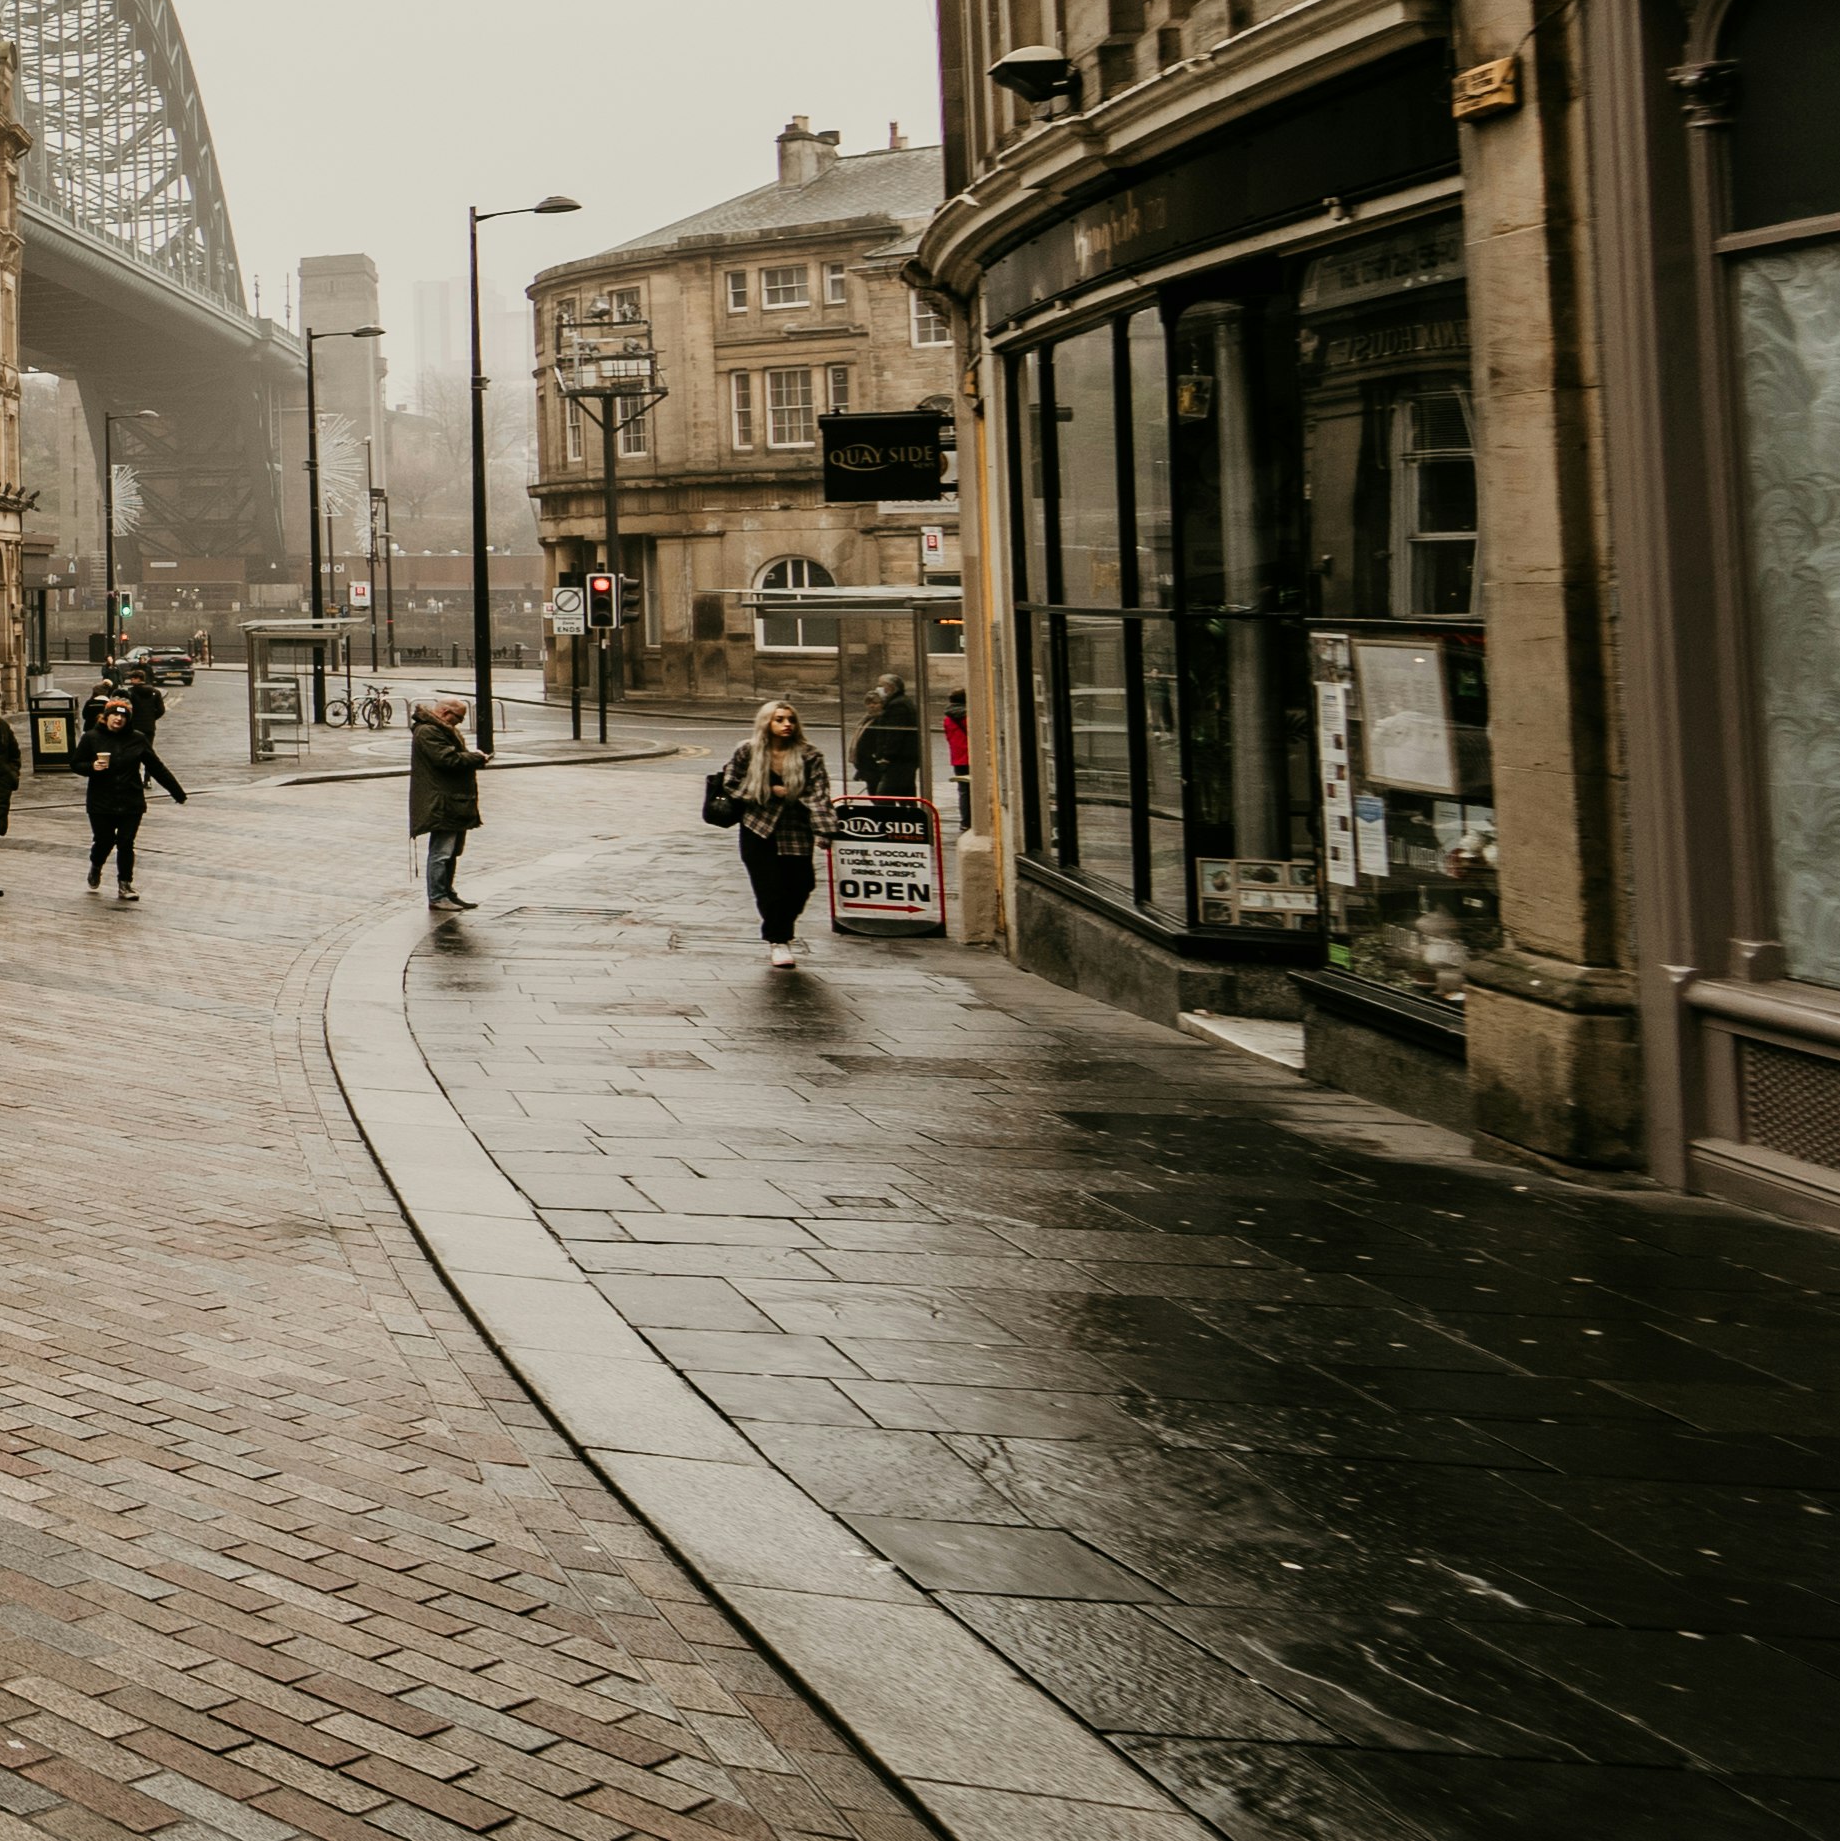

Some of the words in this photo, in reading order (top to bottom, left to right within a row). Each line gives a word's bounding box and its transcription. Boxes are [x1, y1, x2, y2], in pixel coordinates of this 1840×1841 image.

[830, 447, 883, 466] QUAY
[889, 445, 934, 462] SIDE
[837, 820, 882, 834] QUAY
[885, 821, 925, 835] SIDE
[886, 870, 916, 878] CRISPS
[839, 879, 931, 902] OPEN
